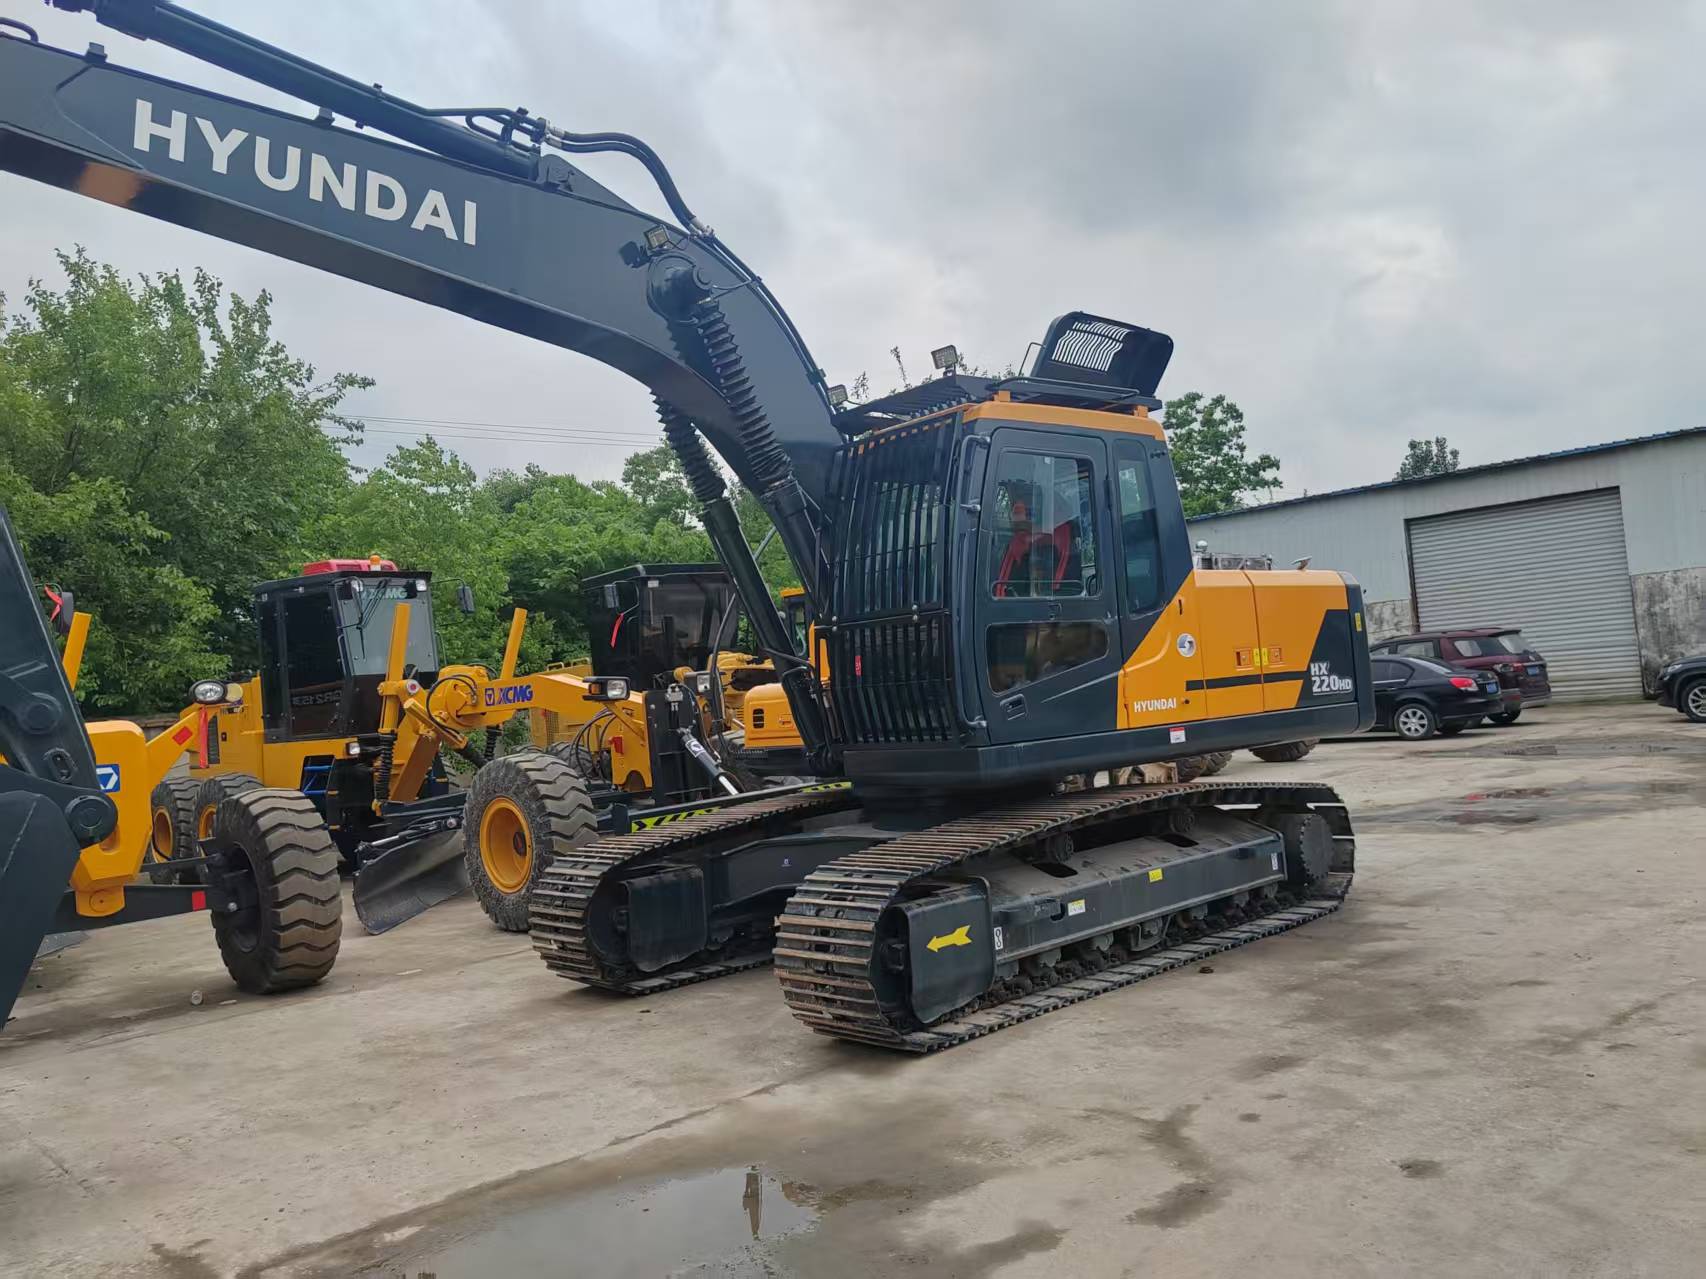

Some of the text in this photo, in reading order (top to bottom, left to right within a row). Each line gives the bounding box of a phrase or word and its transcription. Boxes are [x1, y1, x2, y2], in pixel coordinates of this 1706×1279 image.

[133, 98, 477, 247] HYUNDAI
[1310, 662, 1329, 676] HX
[496, 684, 533, 704] XCMG
[1134, 697, 1177, 713] HYUNDAI
